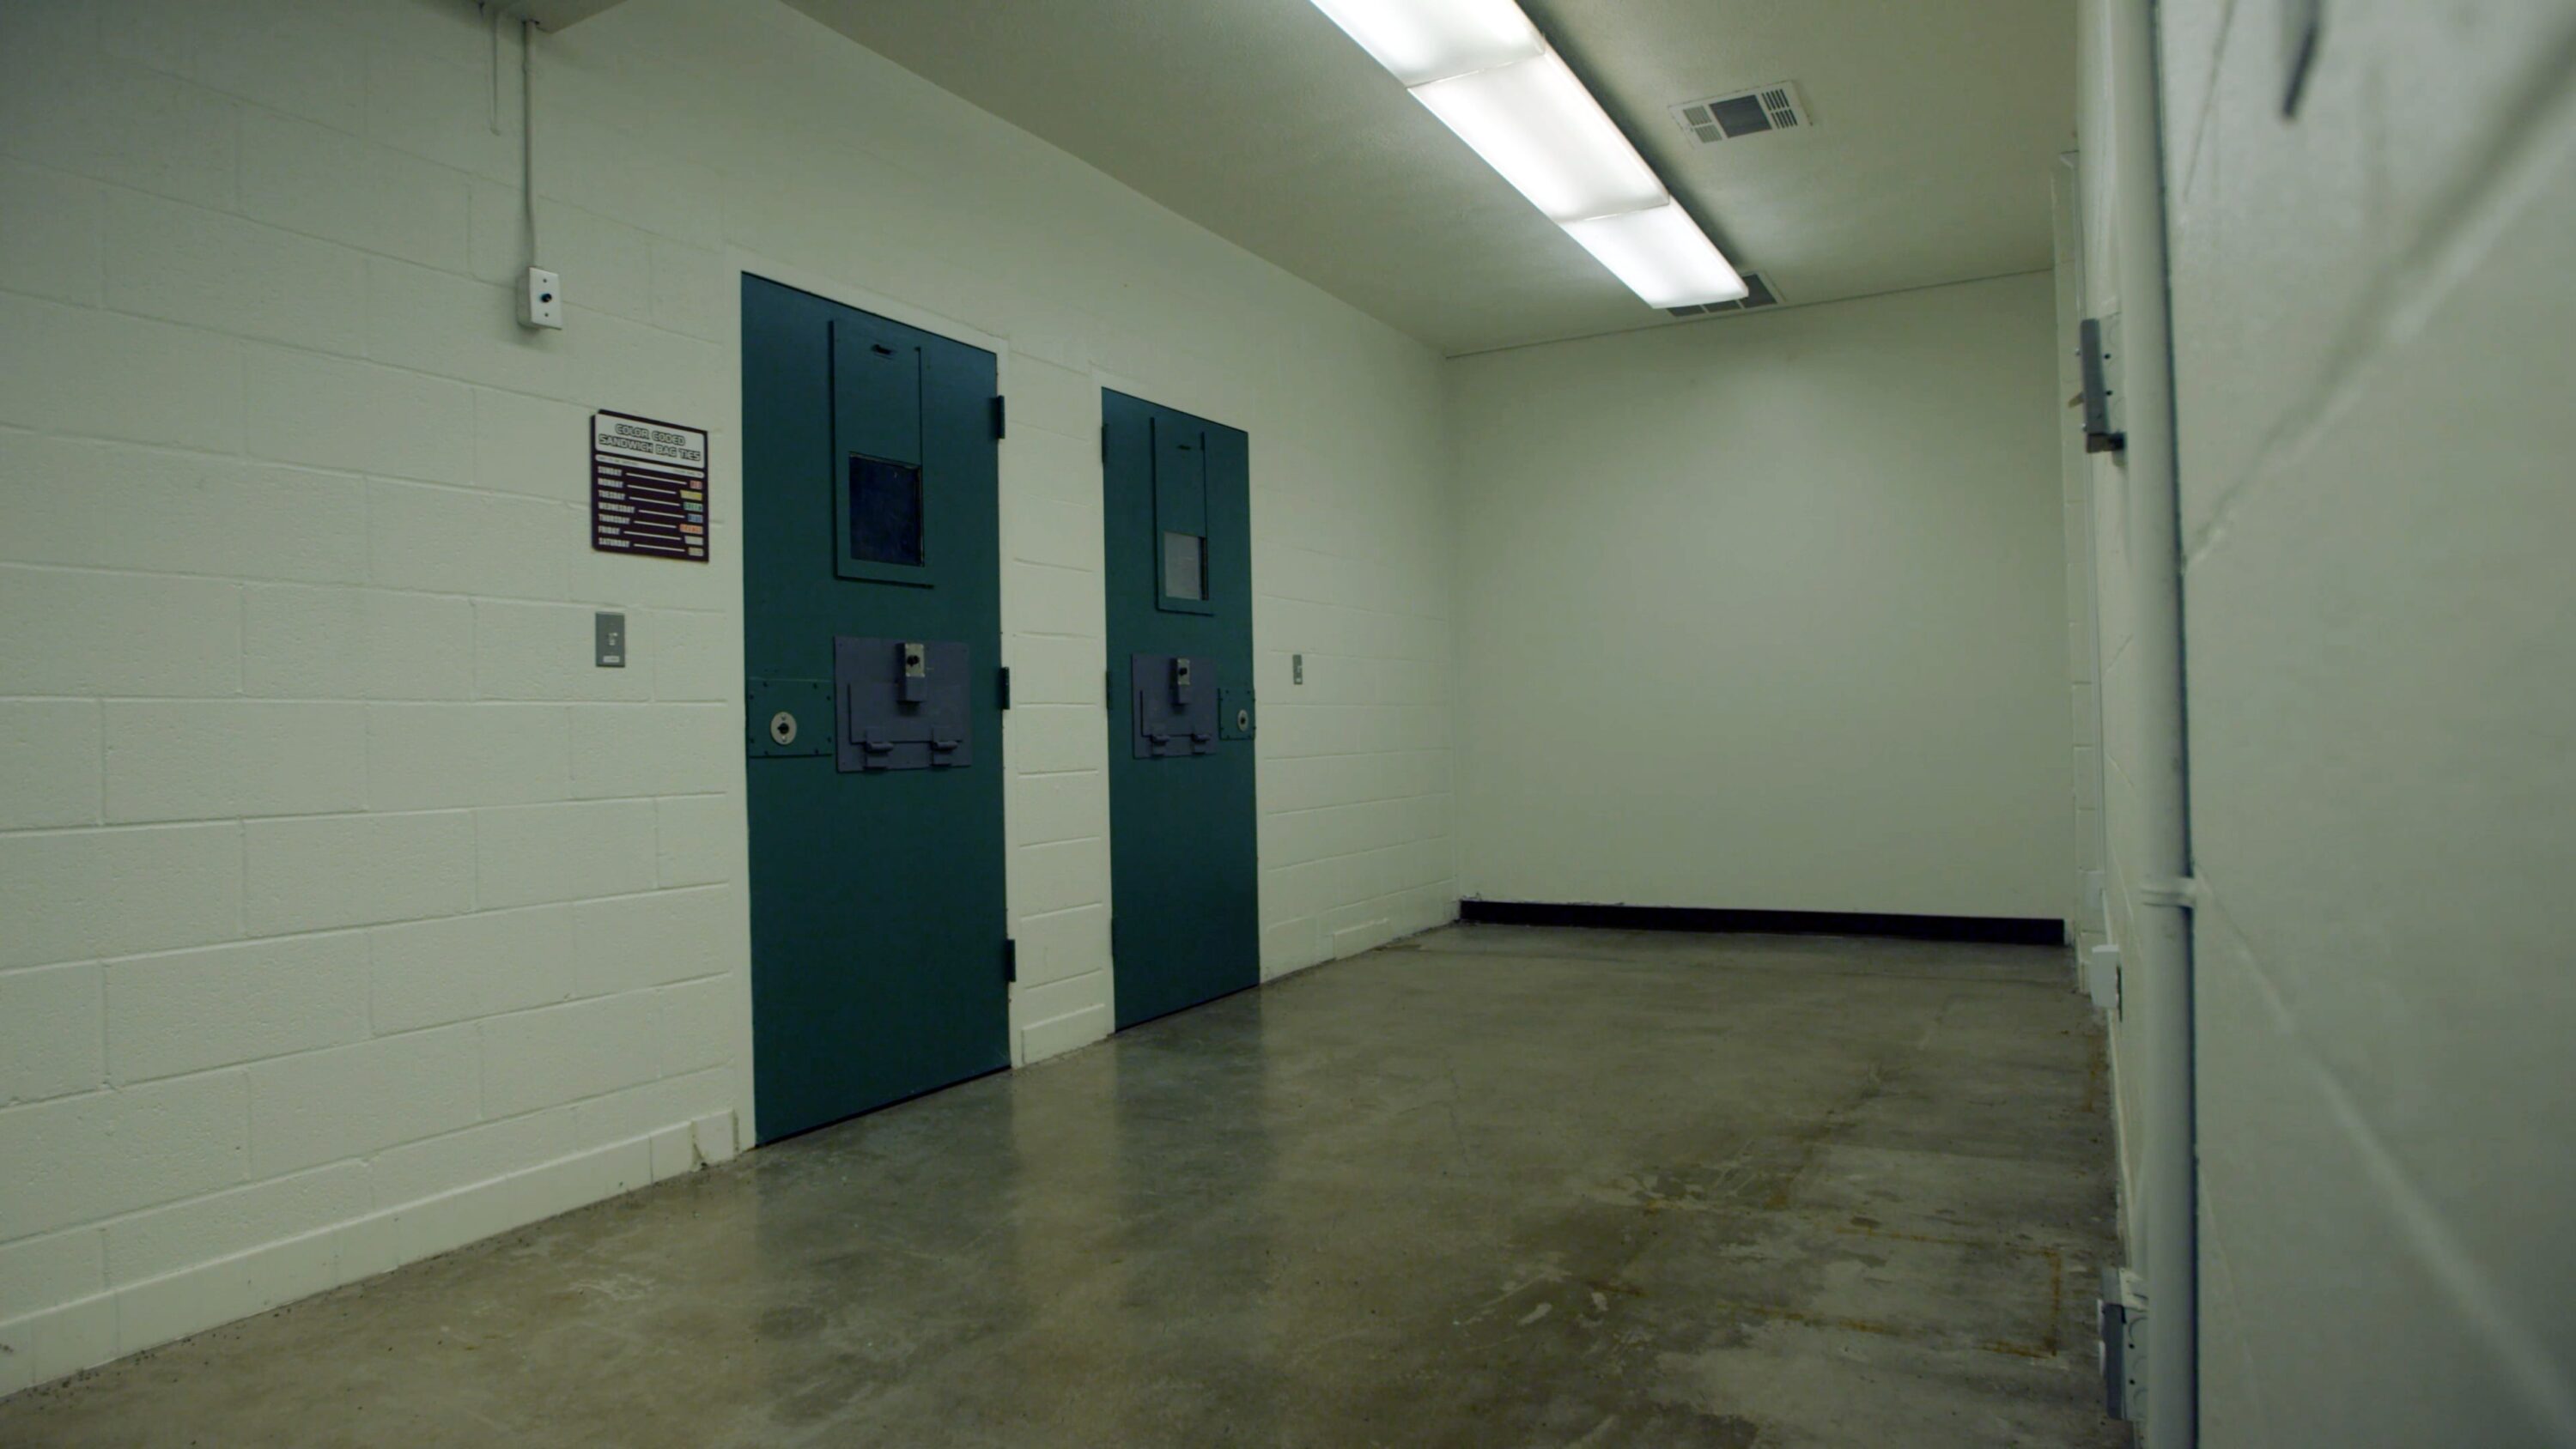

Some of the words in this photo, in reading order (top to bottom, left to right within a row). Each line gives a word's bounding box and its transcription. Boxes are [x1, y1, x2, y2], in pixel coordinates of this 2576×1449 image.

[598, 433, 653, 452] SANDWICH
[655, 444, 677, 458] BAG
[678, 448, 701, 461] TIES
[615, 423, 649, 439] COLOR
[652, 430, 685, 446] CODED
